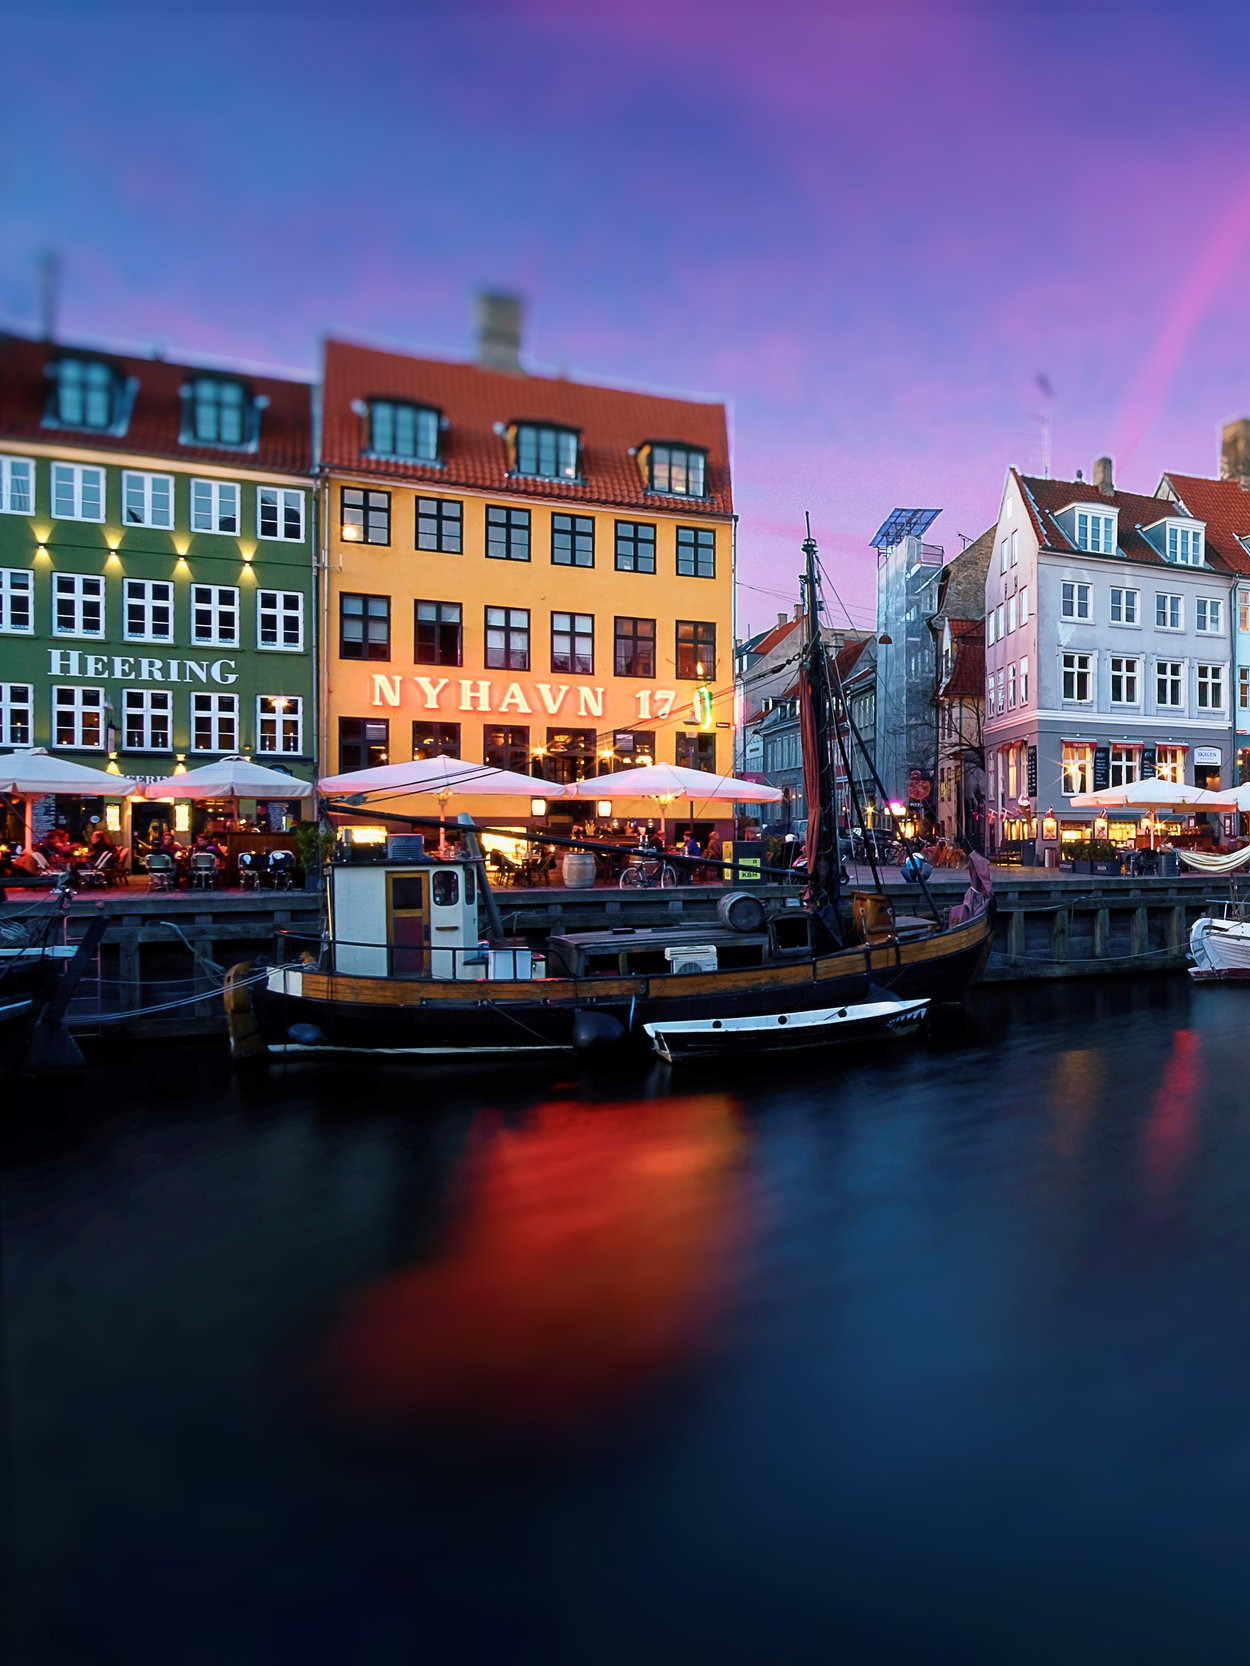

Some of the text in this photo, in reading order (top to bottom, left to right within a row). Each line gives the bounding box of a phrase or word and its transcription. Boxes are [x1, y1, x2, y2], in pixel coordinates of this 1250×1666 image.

[48, 649, 239, 685] HEERING
[372, 674, 676, 719] NYHAVN 17
